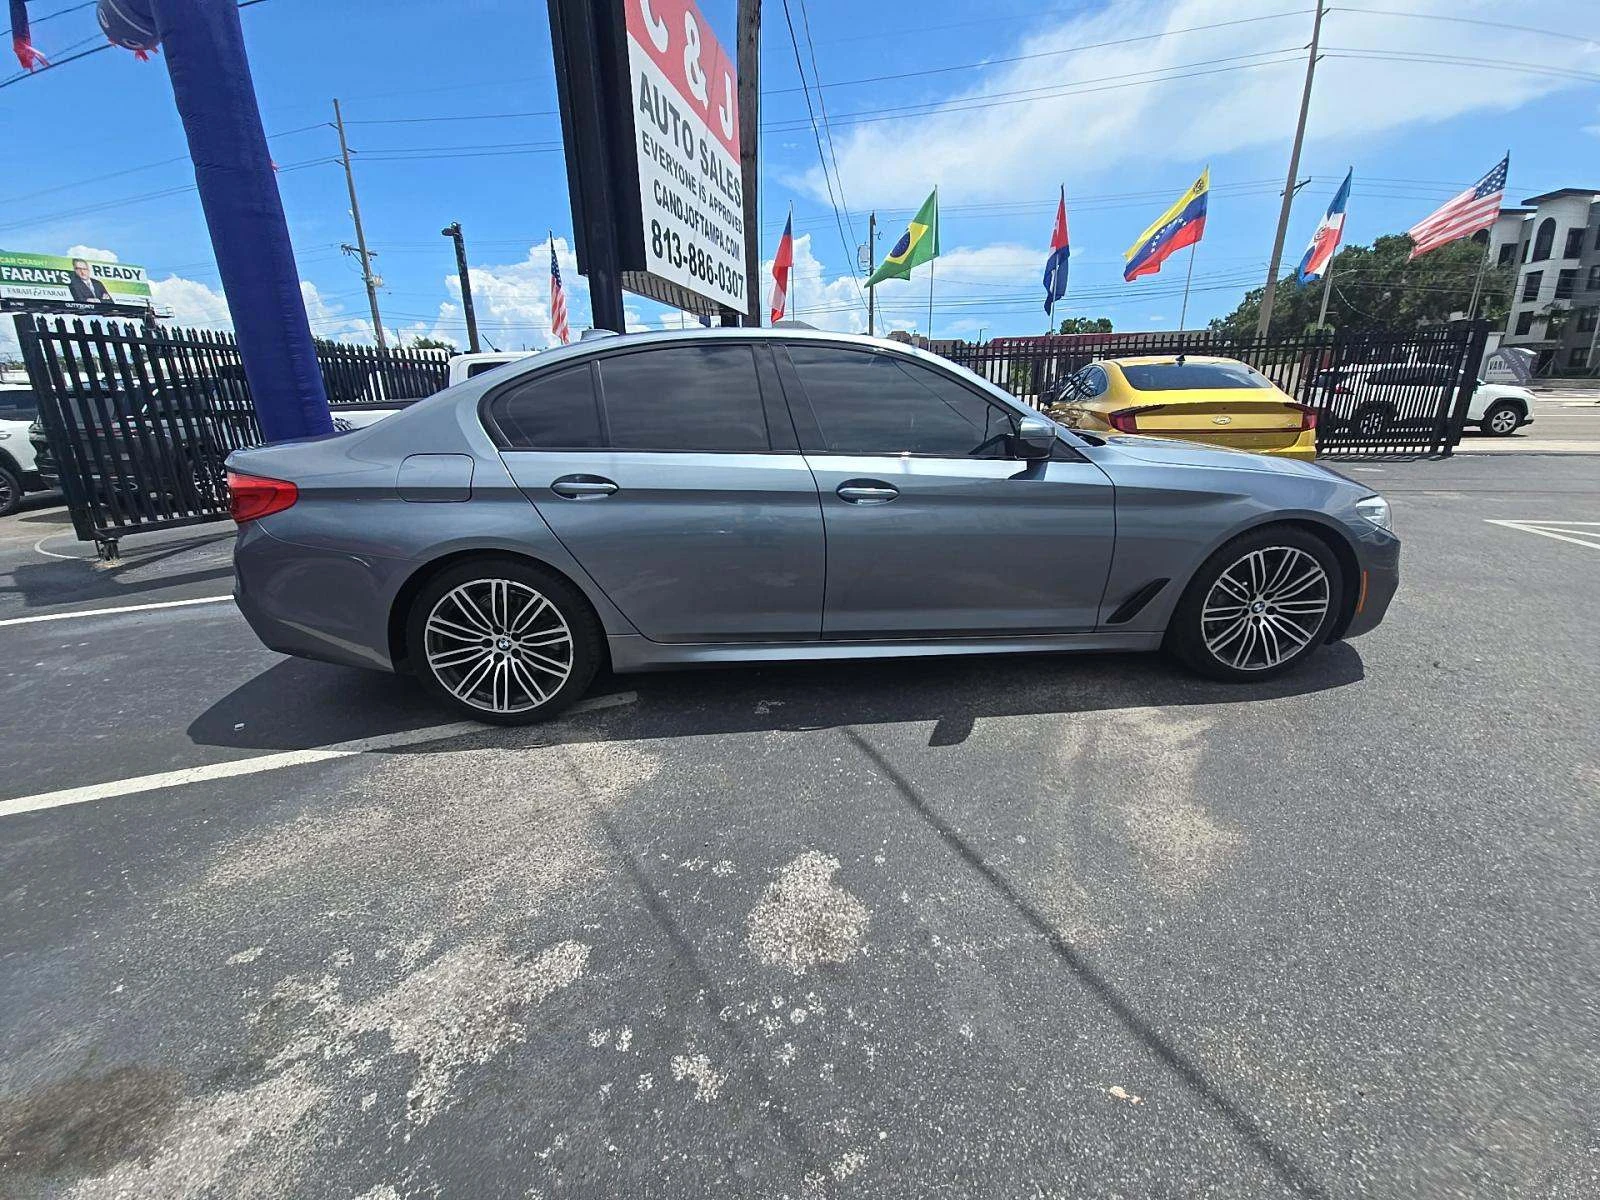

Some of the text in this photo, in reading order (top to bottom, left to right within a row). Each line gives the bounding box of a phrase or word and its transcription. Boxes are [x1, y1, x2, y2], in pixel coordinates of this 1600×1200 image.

[683, 10, 708, 110] &
[719, 72, 733, 141] J
[640, 71, 742, 208] AUTO SALES
[642, 130, 742, 234] EVERYONE IS APPROVED
[651, 218, 744, 299] 813-886-0307
[654, 178, 740, 261] CANDJOFTAMPA.COM
[1, 264, 141, 284] FARAH'S READY
